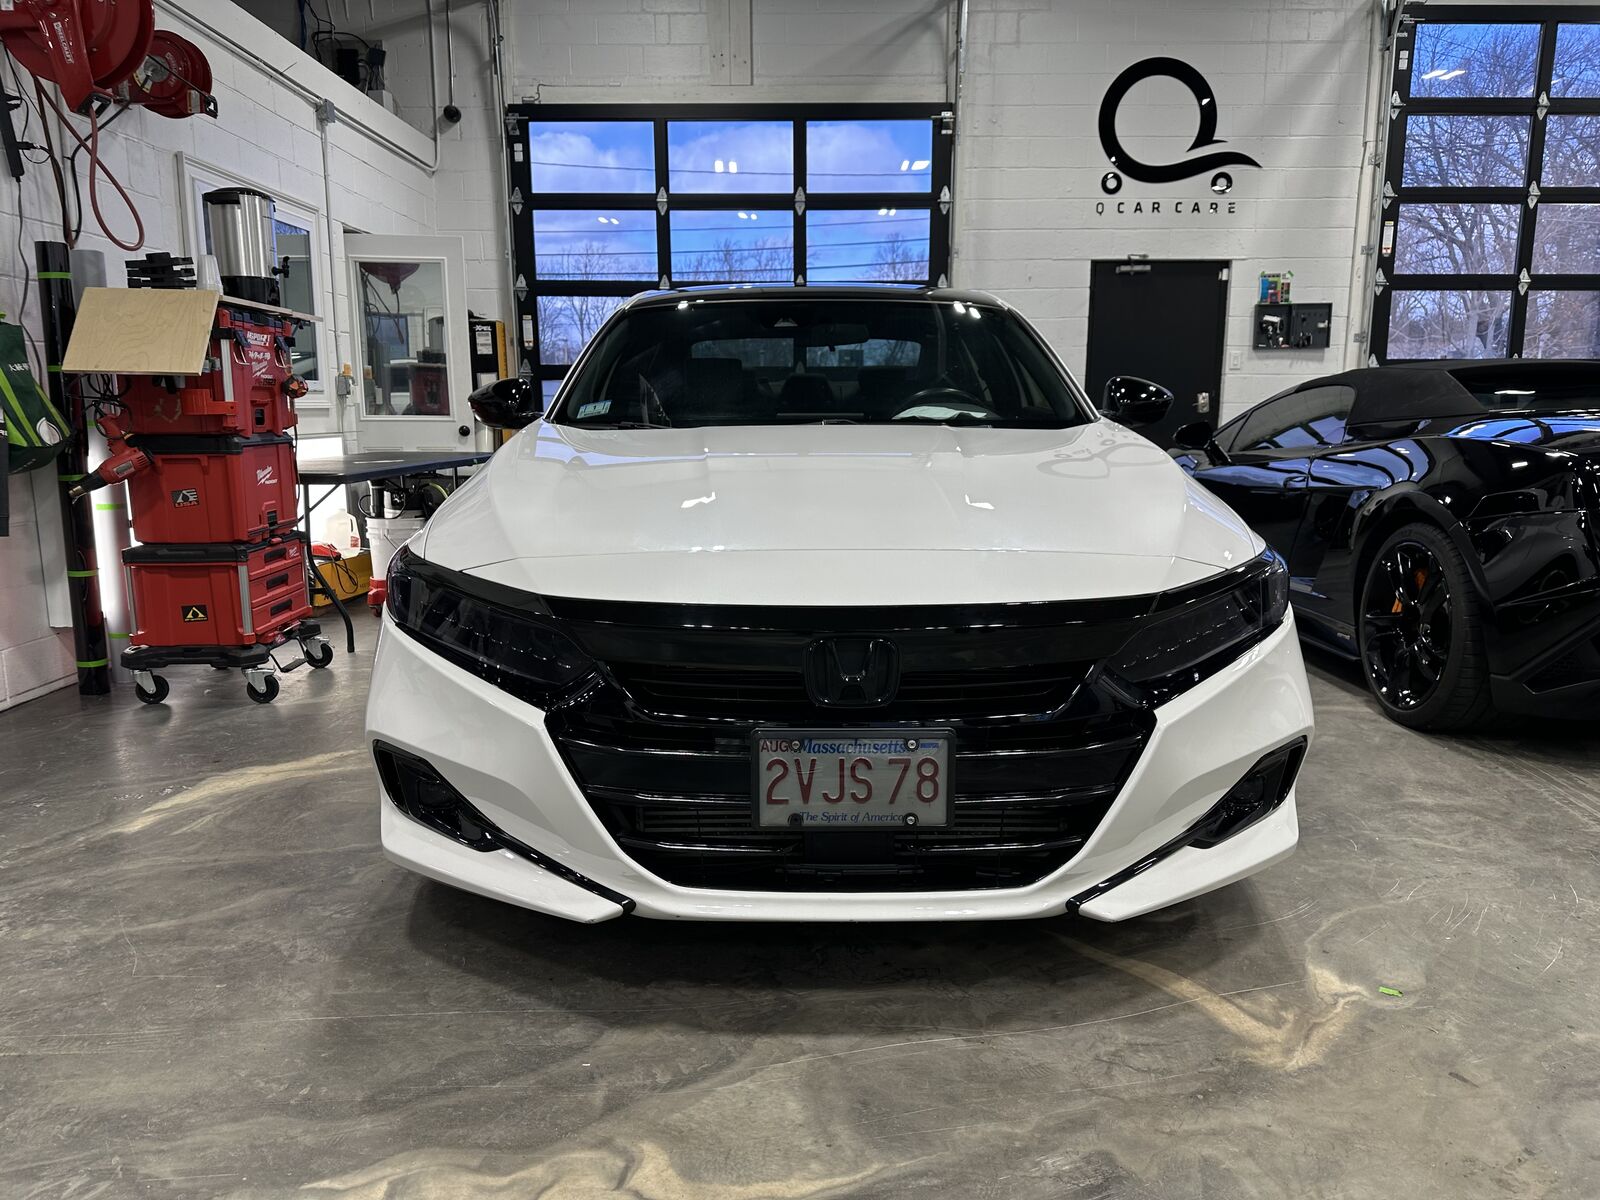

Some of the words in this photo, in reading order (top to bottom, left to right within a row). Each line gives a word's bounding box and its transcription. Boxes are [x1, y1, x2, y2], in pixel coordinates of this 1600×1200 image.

[1096, 202, 1105, 216] Q
[1117, 201, 1161, 214] CAR
[1174, 201, 1236, 214] CARE
[760, 739, 789, 752] AUG
[801, 738, 906, 755] Massachusetts
[801, 811, 818, 822] The
[822, 811, 848, 824] Spirit
[850, 811, 860, 824] of
